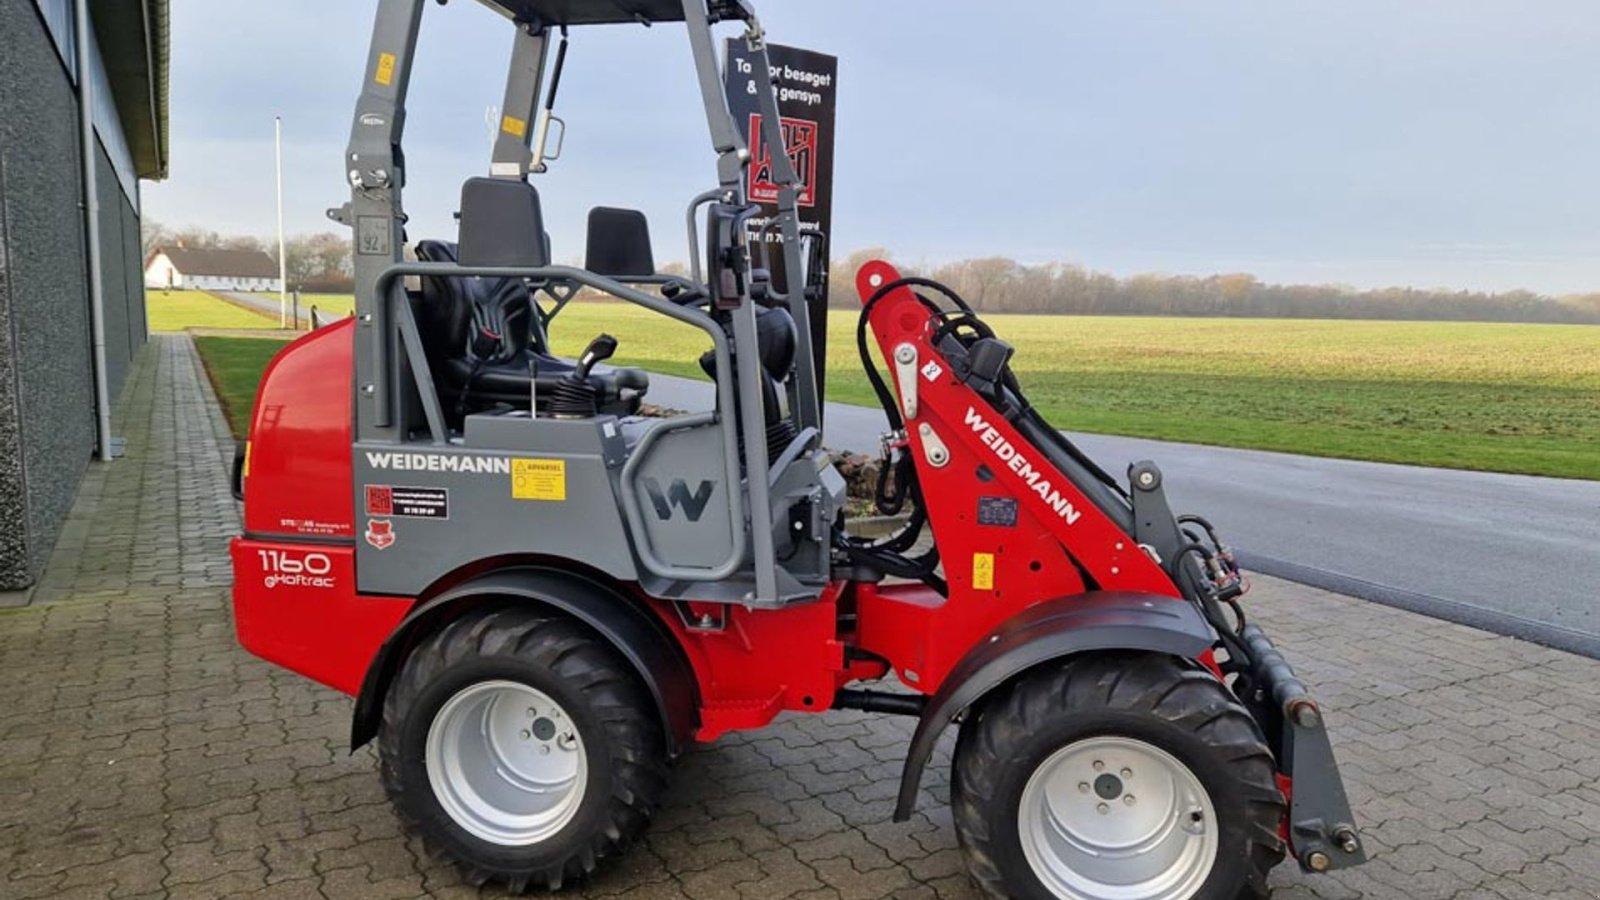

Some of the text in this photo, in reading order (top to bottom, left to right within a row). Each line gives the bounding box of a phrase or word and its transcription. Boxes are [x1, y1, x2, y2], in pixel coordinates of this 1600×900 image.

[735, 58, 752, 73] Ta
[768, 66, 782, 77] or
[746, 80, 758, 94] &
[780, 87, 821, 106] gensyn
[366, 452, 510, 473] WEIDEMANN
[964, 406, 1081, 526] WEIDEMANN
[258, 549, 331, 575] 1160
